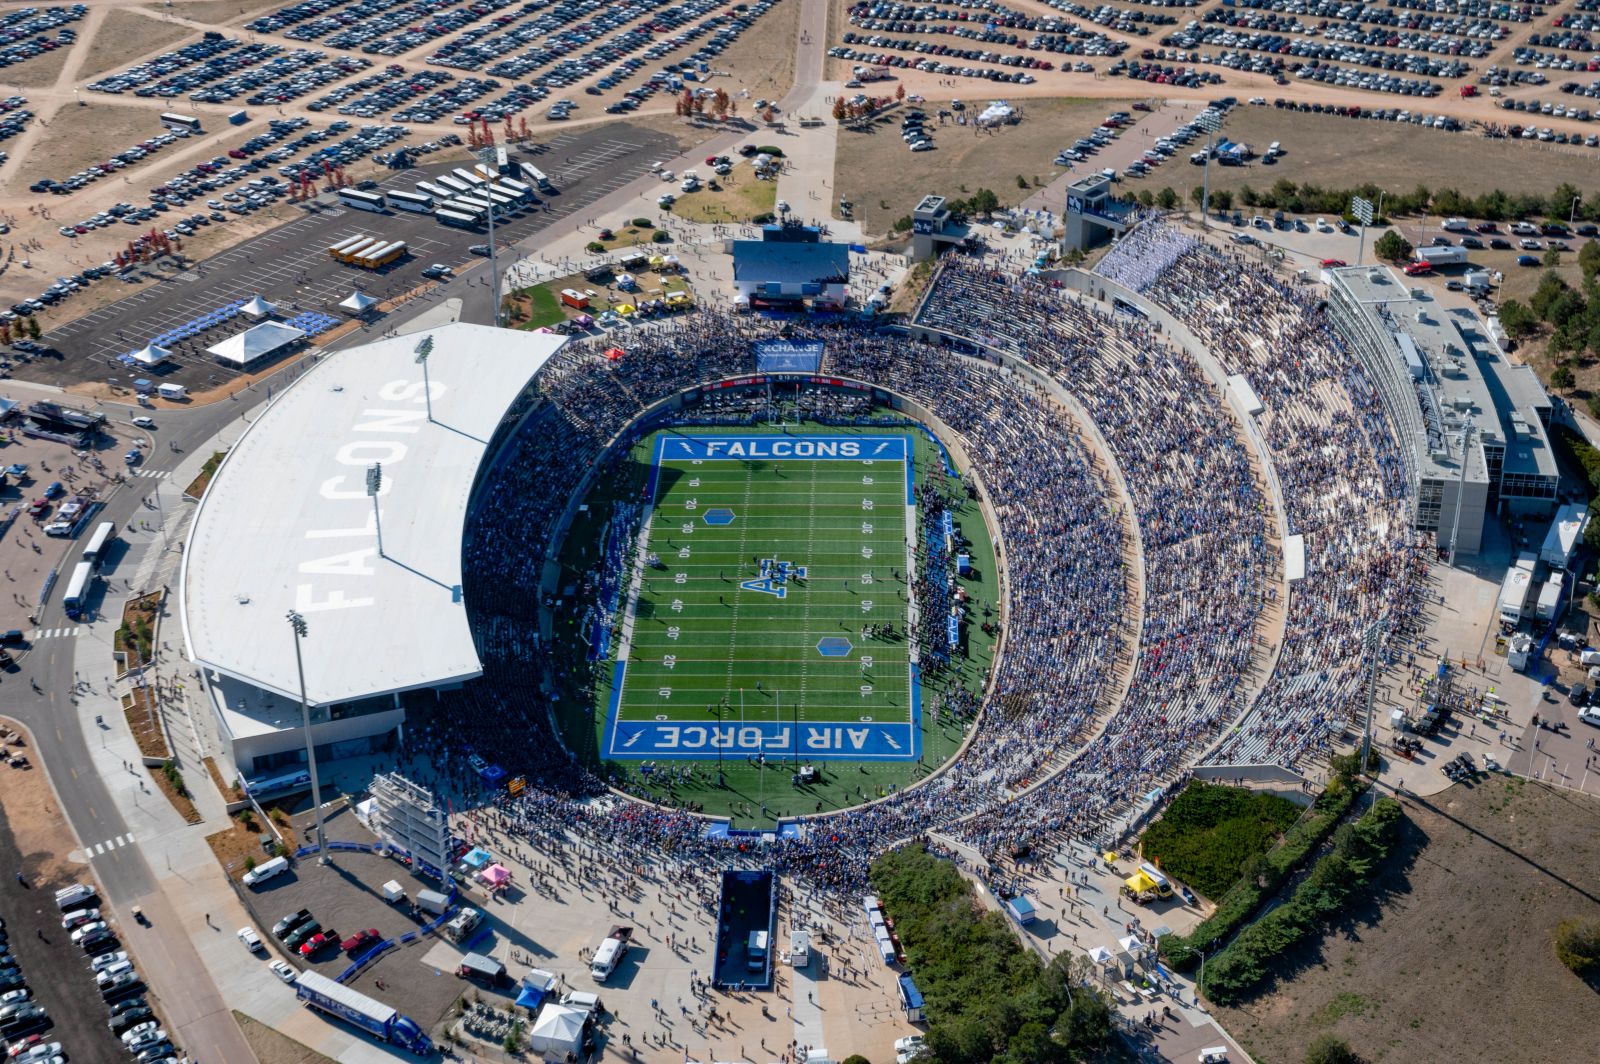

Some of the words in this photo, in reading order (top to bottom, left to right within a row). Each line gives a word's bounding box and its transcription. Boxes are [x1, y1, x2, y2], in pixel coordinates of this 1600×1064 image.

[706, 441, 860, 457] FALCONS
[296, 379, 448, 613] FALCONS
[686, 500, 697, 509] 20
[862, 500, 873, 510] 20
[682, 524, 694, 533] 30
[862, 524, 873, 534] 30
[679, 548, 690, 558] 40
[862, 548, 873, 558] 40
[675, 574, 688, 584] 50
[862, 574, 873, 584] 50
[672, 599, 683, 610] 40
[862, 600, 872, 611] 40
[667, 626, 680, 638] 30
[664, 654, 676, 666] 20
[861, 656, 872, 668] 20
[659, 687, 672, 696] 10
[861, 686, 872, 694] 10
[654, 726, 790, 748] FORCE
[807, 728, 870, 749] AIR
